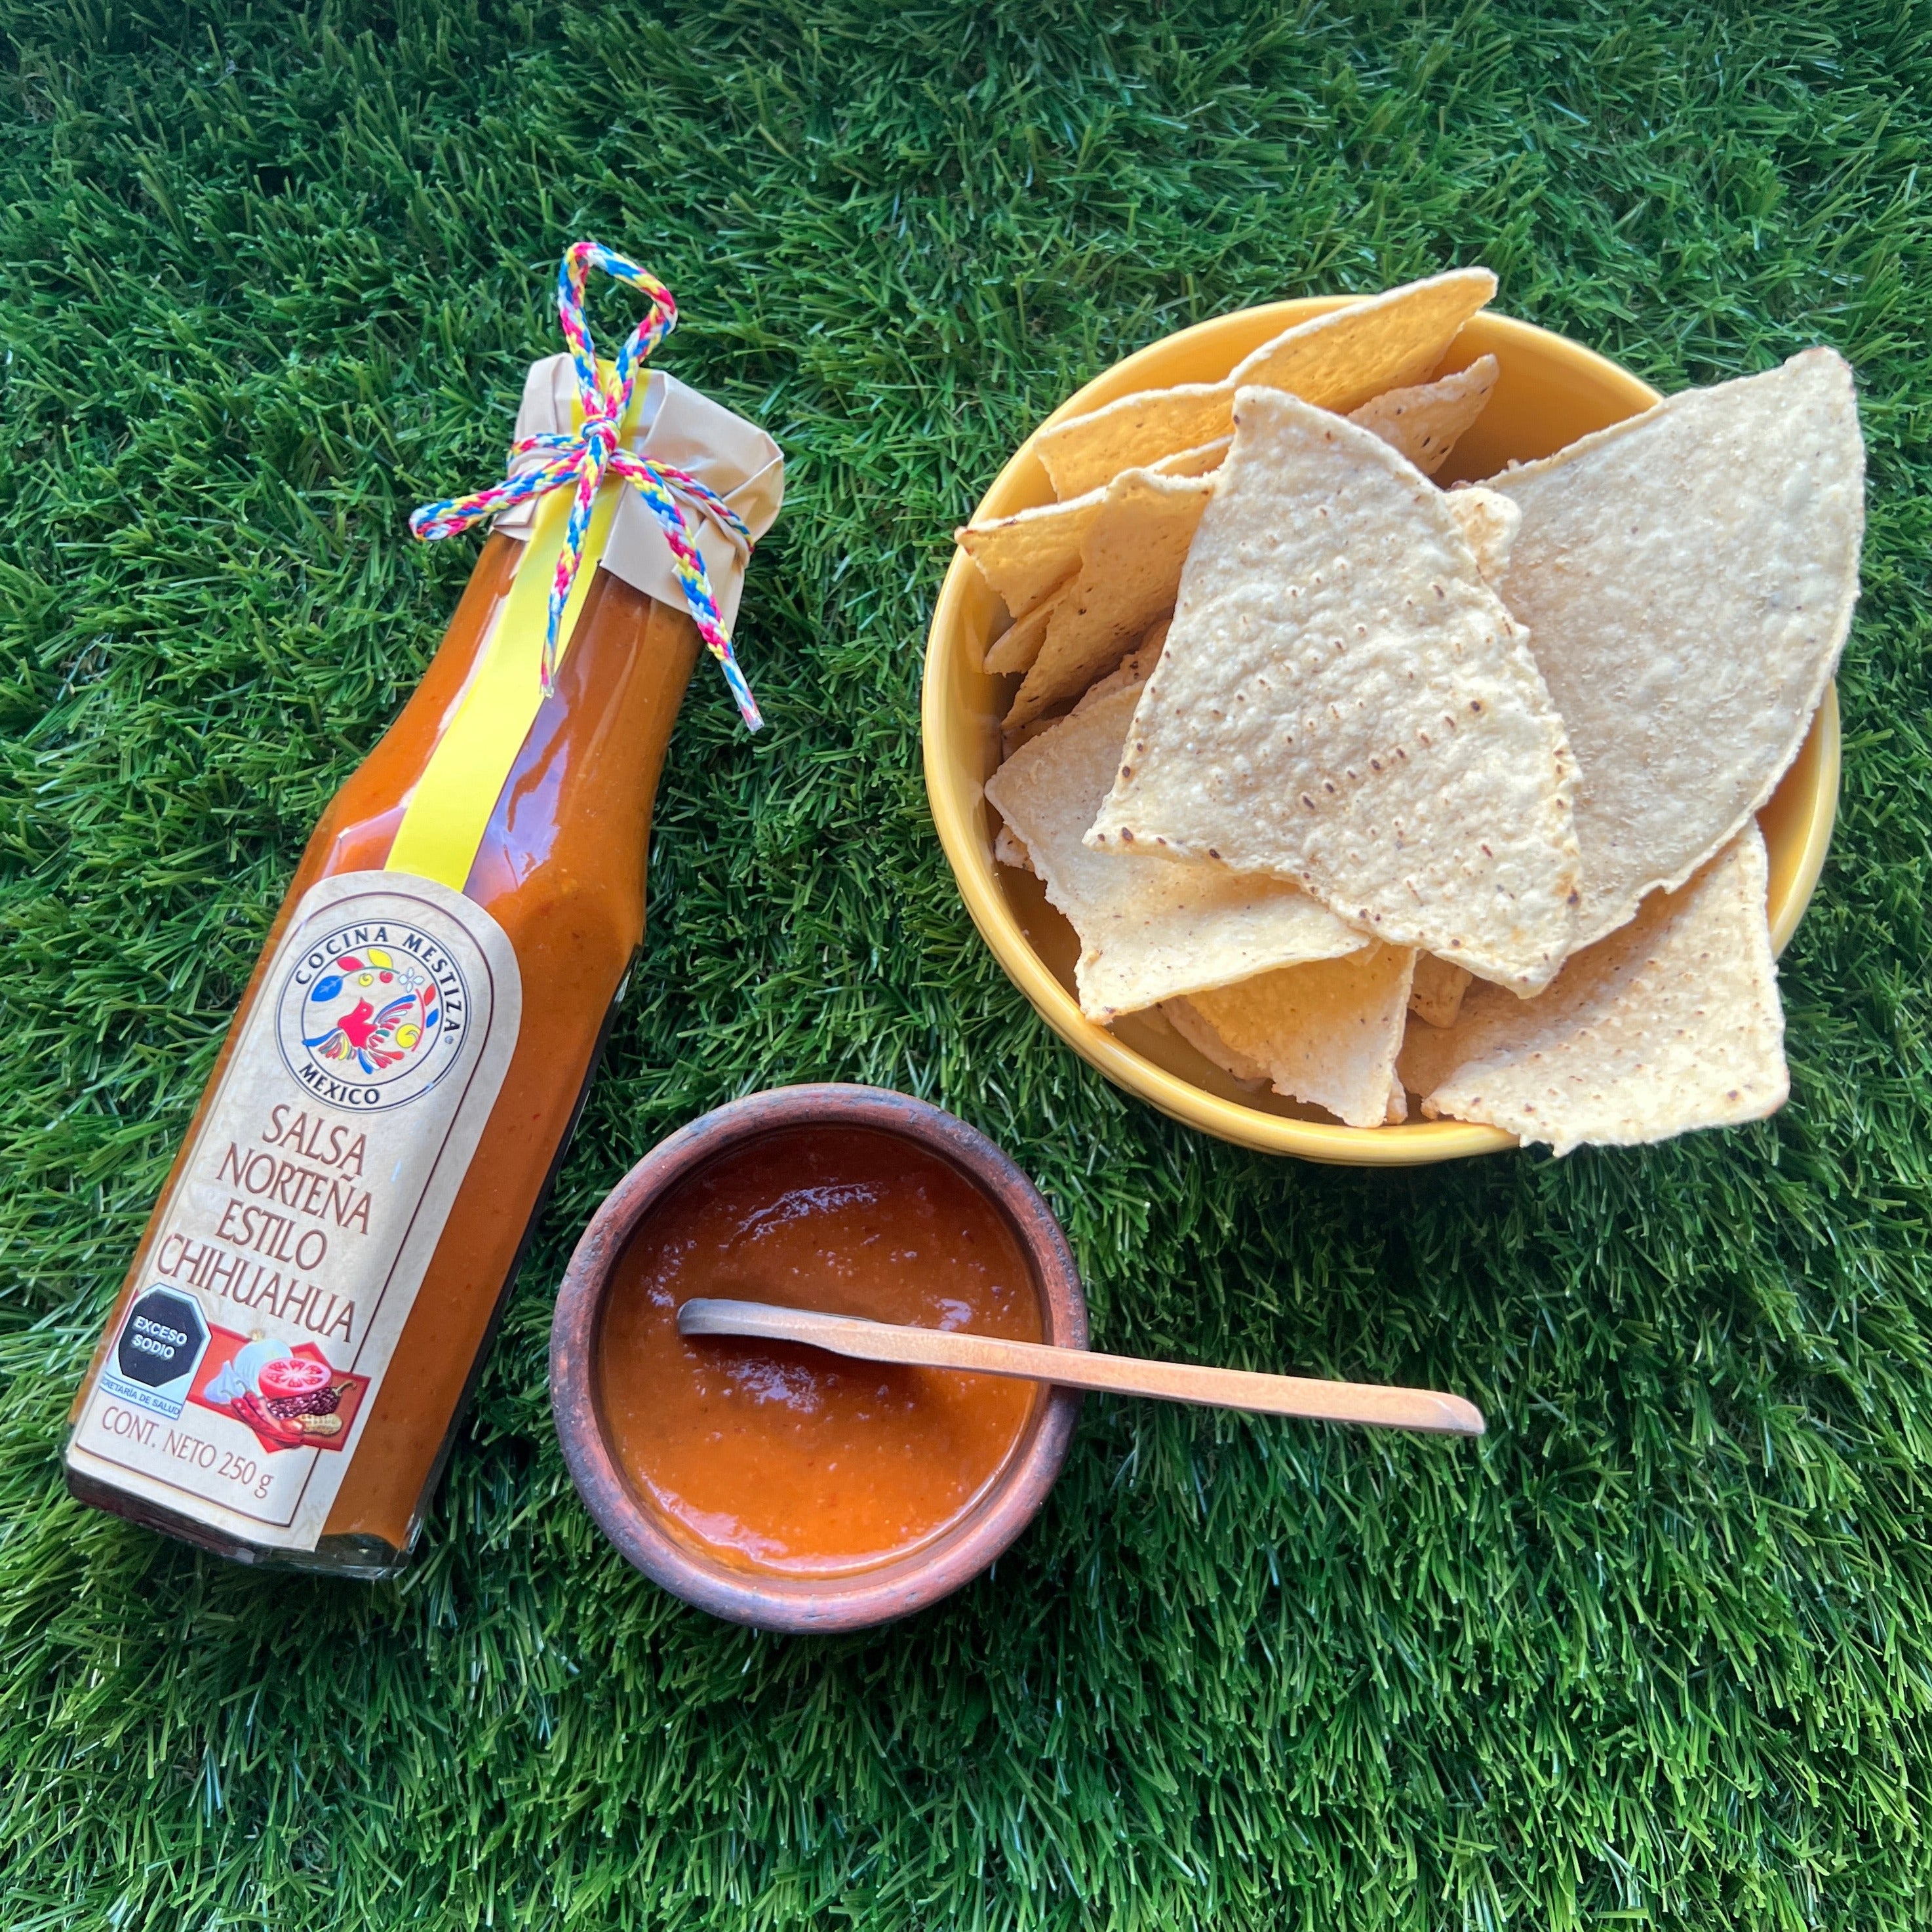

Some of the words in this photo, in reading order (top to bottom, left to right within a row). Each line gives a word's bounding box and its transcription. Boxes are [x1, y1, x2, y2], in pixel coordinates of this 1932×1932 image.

[295, 926, 389, 985] COCINA
[402, 932, 463, 1033] MESTIZA
[299, 1062, 380, 1105] MEXICO
[262, 1103, 367, 1177] SALSA
[216, 1141, 372, 1235] NORTEÑA
[214, 1198, 328, 1271] ESTILO
[158, 1232, 356, 1343] CHIHUAHUA
[131, 1333, 175, 1359] SODIO
[132, 1315, 187, 1346] EXCESO
[139, 1393, 151, 1404] DE
[152, 1399, 180, 1415] SALUD
[102, 1406, 159, 1448] CONT.
[162, 1429, 217, 1468] NETO
[218, 1451, 256, 1485] 250
[254, 1474, 274, 1499] g
